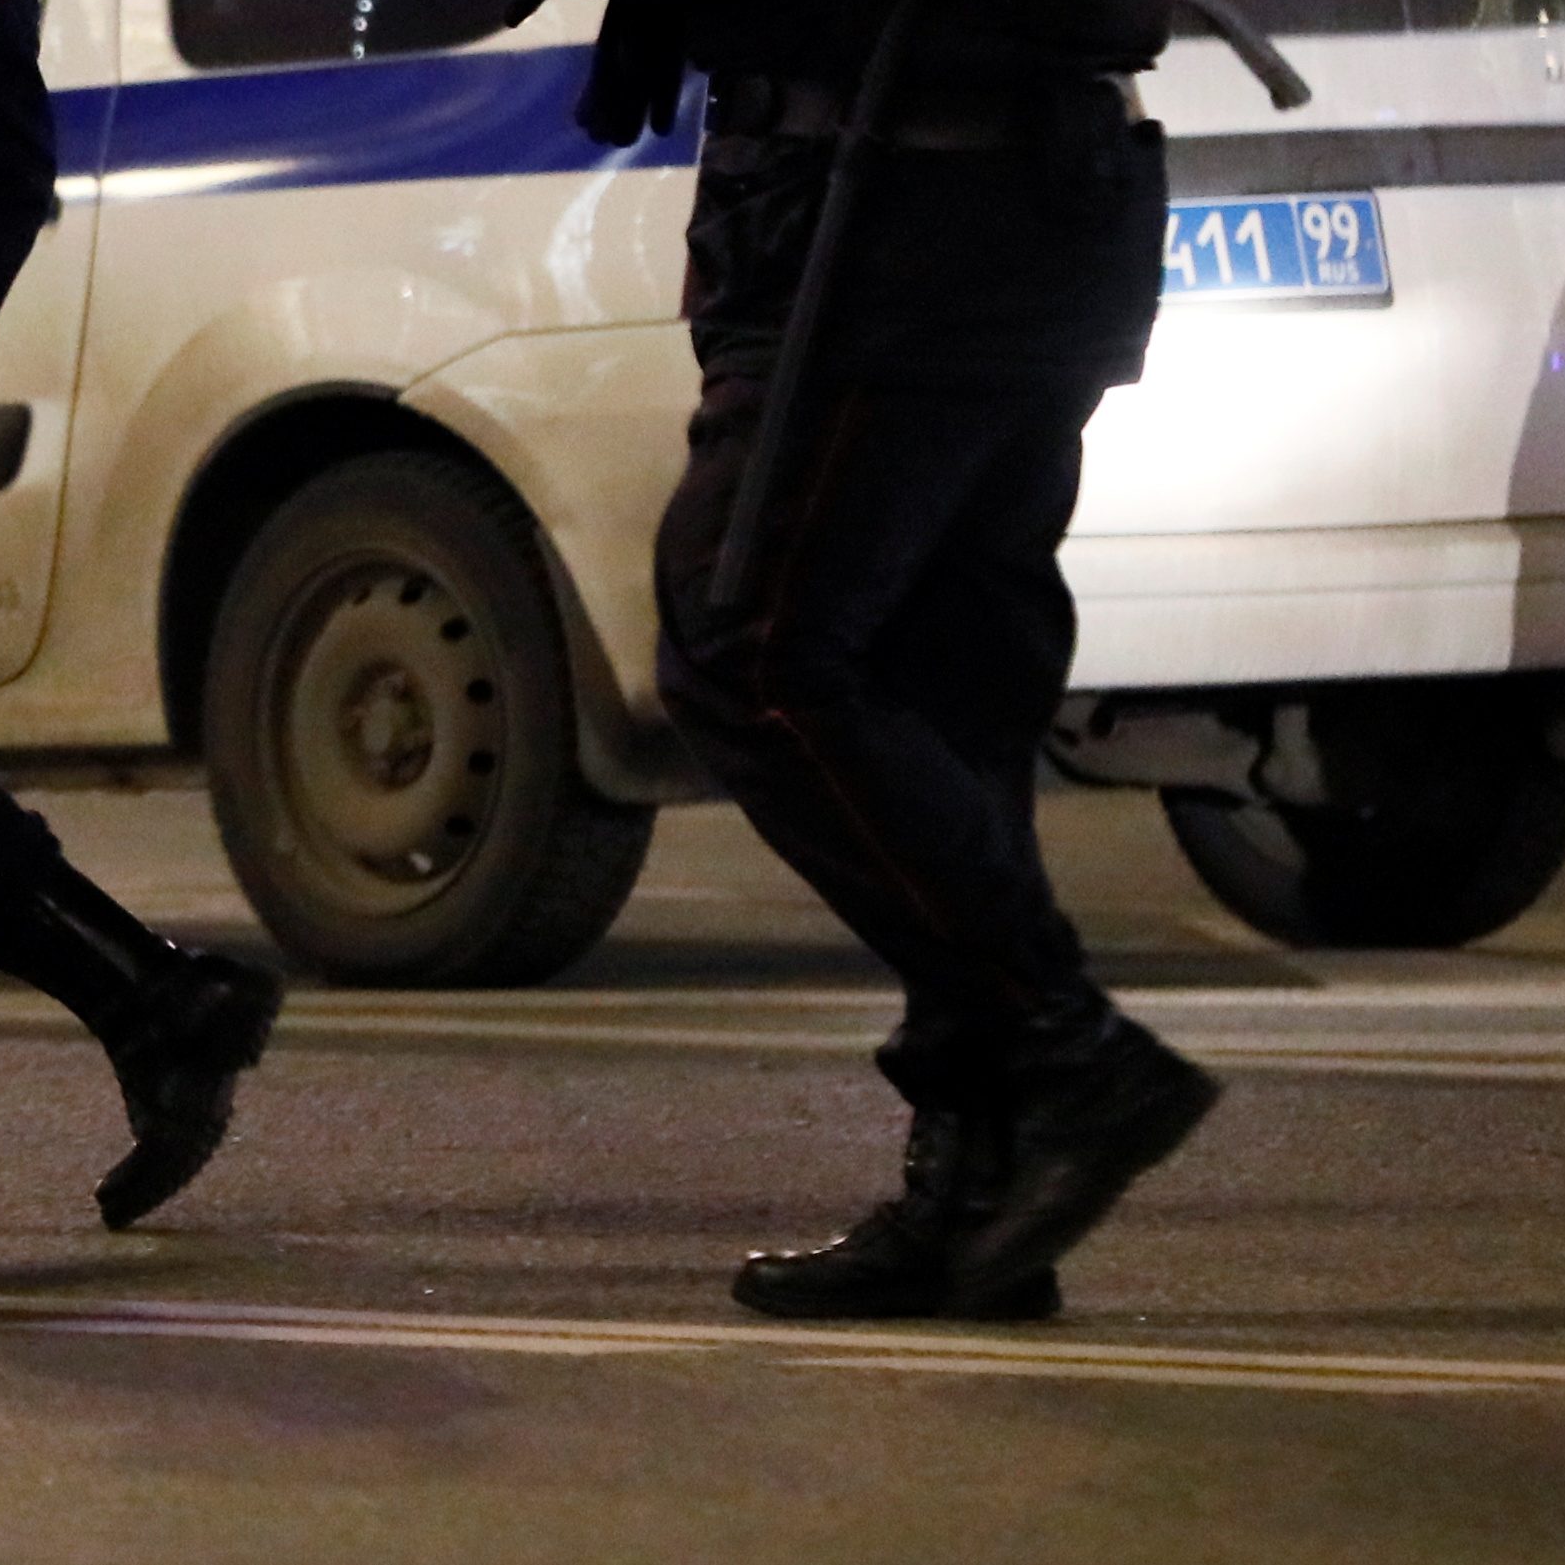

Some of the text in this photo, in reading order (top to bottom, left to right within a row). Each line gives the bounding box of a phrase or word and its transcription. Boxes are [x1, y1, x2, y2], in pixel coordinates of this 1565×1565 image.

[1162, 204, 1360, 285] 411 99
[1318, 260, 1361, 285] RUS
